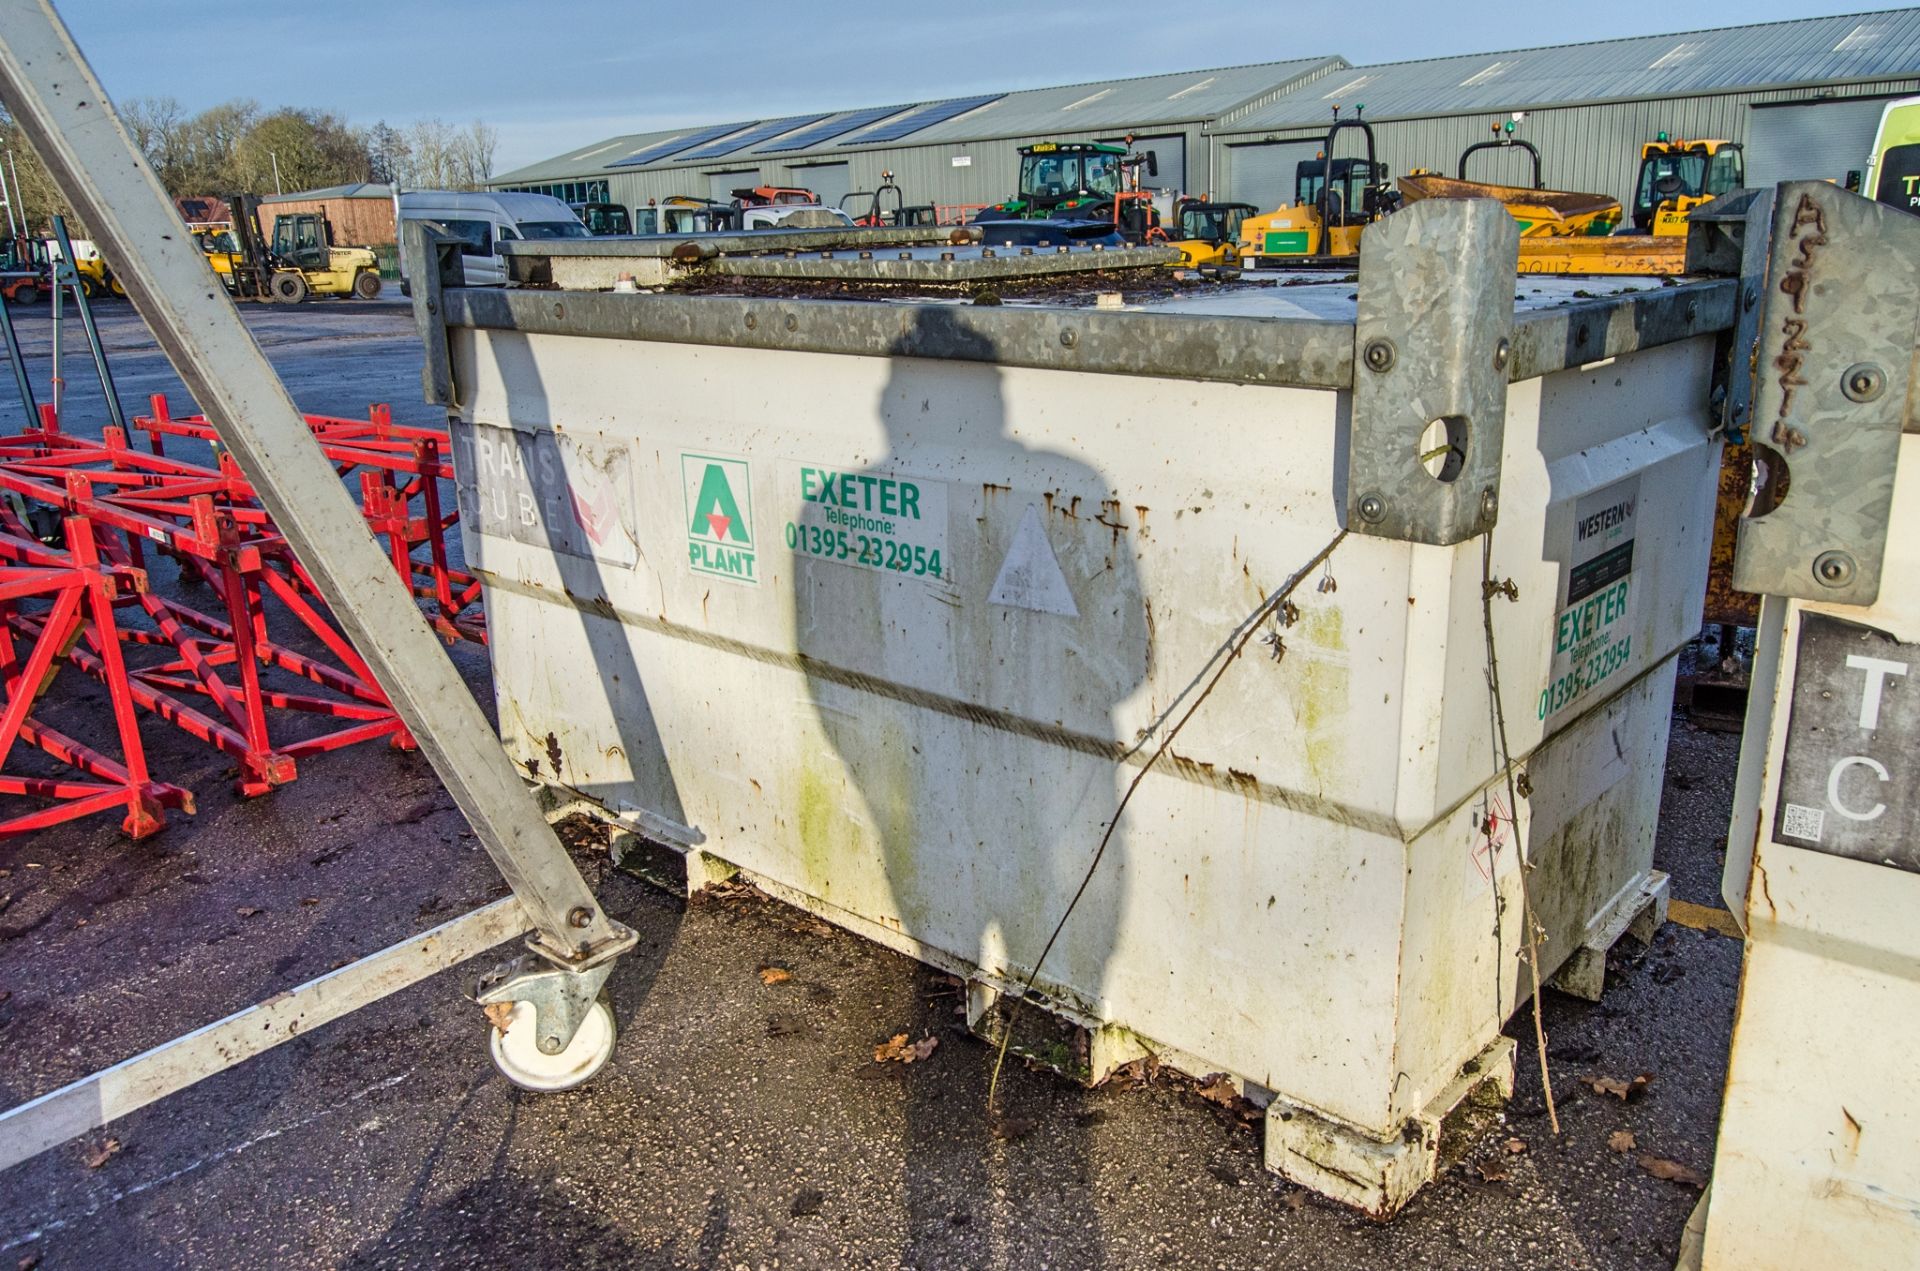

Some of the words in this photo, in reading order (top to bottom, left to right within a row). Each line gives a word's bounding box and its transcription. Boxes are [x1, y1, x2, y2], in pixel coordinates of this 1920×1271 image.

[461, 435, 556, 486] TRANS
[469, 484, 562, 534] CUBE
[691, 463, 751, 544] A
[801, 467, 921, 520] EXETER
[823, 506, 896, 536] Telephone:
[1578, 503, 1625, 542] WESTERN
[689, 543, 756, 577] PLANT
[785, 521, 942, 579] 01395-232954
[1557, 581, 1628, 655] EXETER
[1570, 630, 1612, 666] Telephone:
[1538, 635, 1632, 721] 01395-232954
